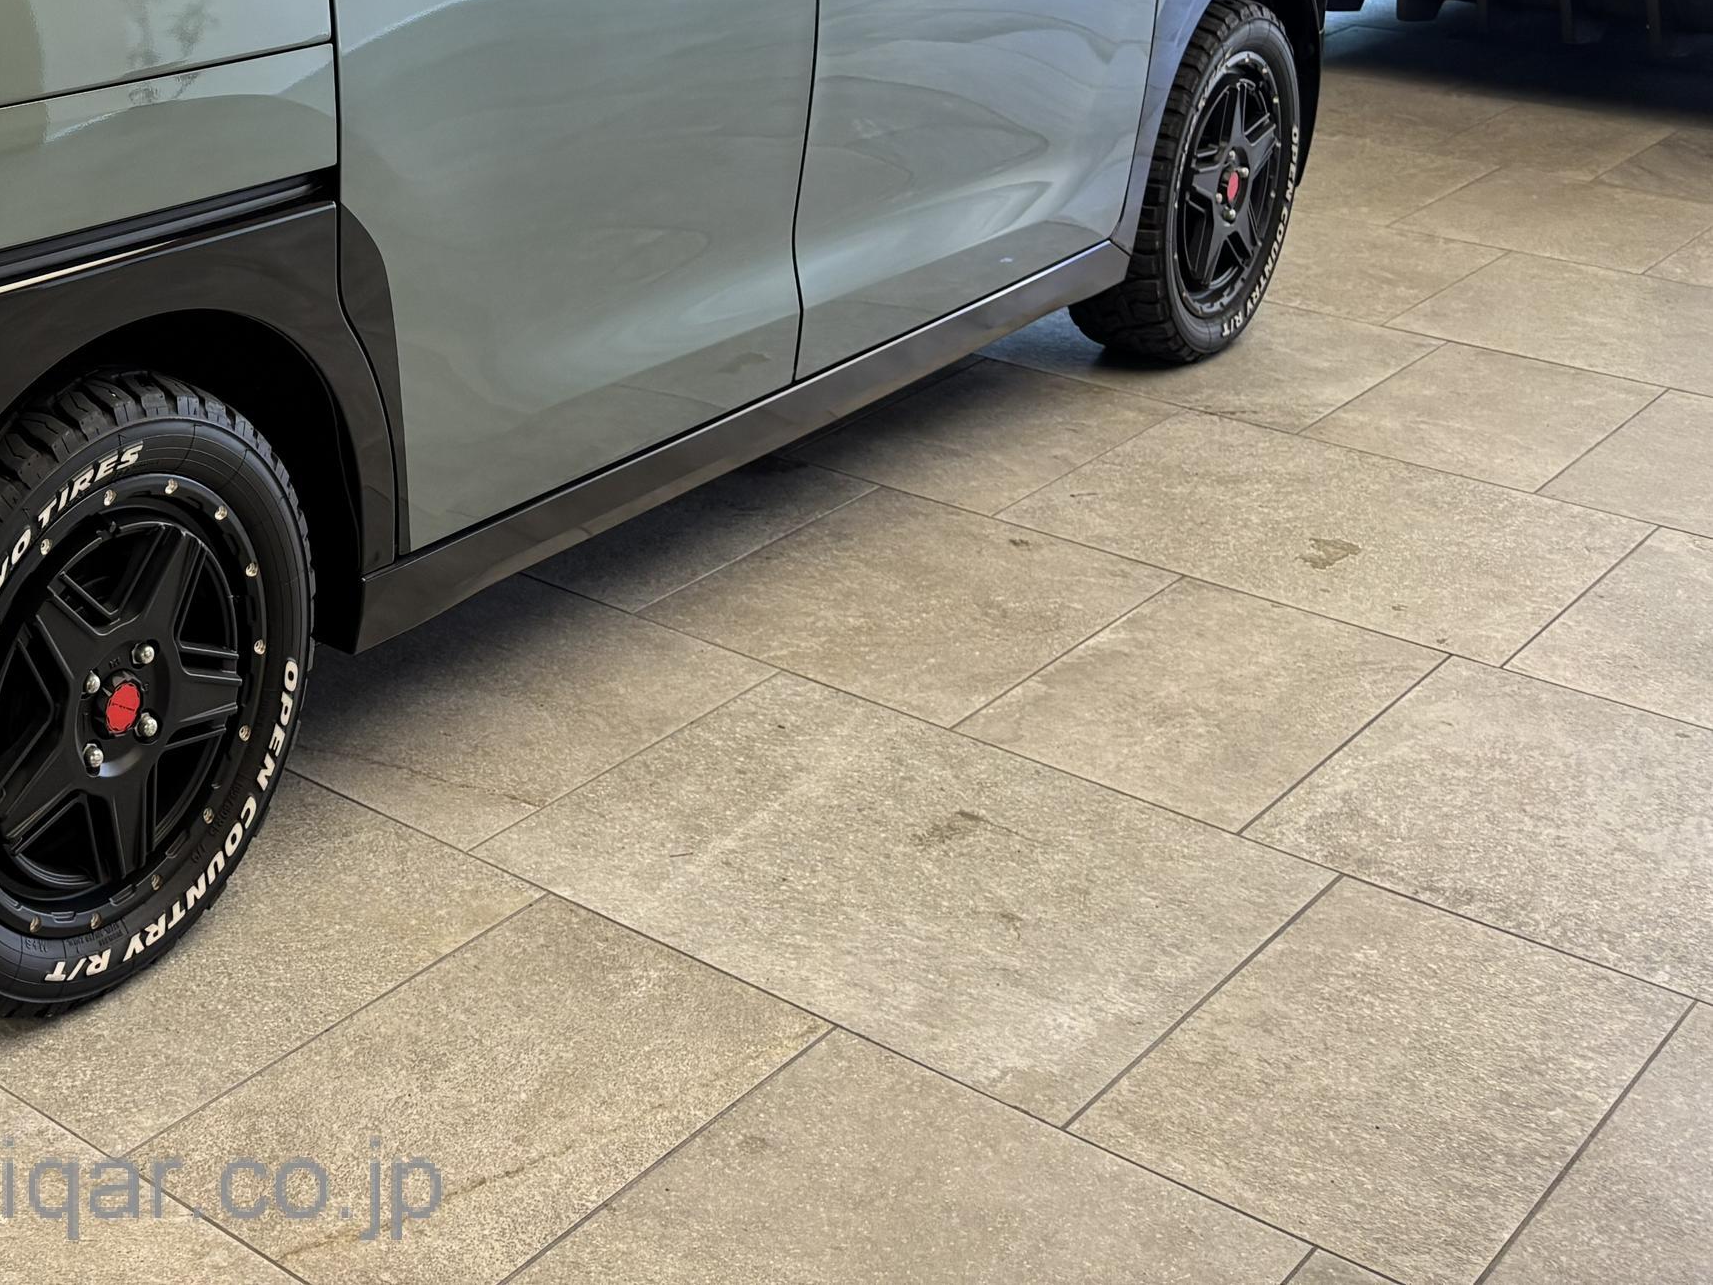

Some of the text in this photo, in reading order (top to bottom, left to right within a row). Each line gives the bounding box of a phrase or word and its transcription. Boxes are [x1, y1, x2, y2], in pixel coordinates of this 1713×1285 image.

[1221, 124, 1300, 338] OPEN COUNTRY R/T
[38, 441, 144, 529] TIRES
[256, 658, 299, 792] OPEN
[122, 794, 257, 964] COUNTRY
[44, 948, 112, 982] R/T
